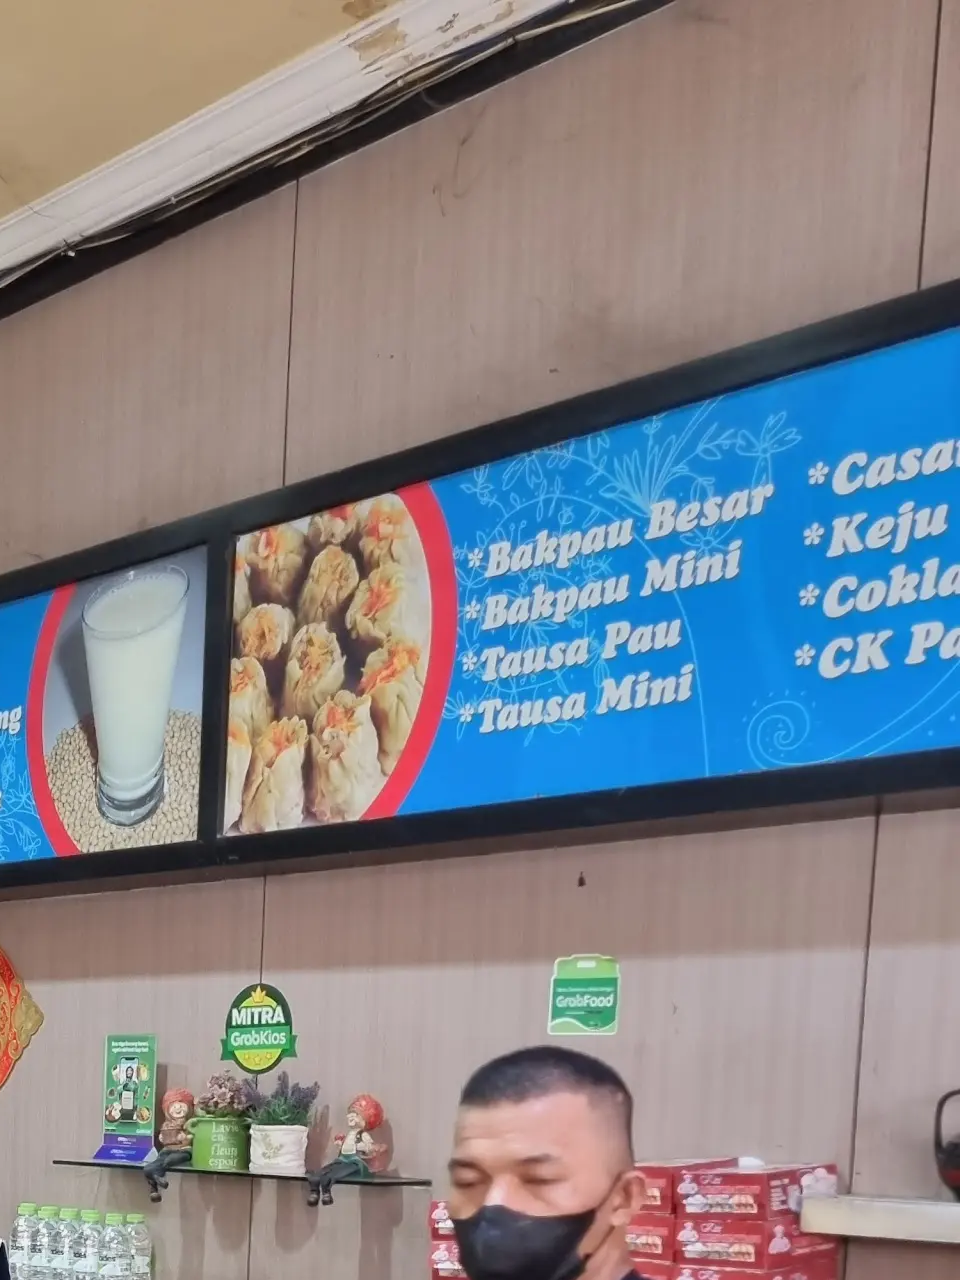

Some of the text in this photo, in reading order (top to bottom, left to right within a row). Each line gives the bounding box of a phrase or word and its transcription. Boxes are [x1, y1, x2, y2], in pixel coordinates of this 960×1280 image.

[831, 437, 960, 496] Casa
[485, 484, 774, 578] Bakpau Besar
[826, 501, 948, 558] Keju
[482, 539, 743, 630] Bakpau Mini
[480, 619, 682, 682] Tausa Pau
[819, 630, 893, 679] CK
[478, 663, 695, 734] Tausa Mini
[231, 1005, 285, 1027] MITRA
[555, 994, 615, 1008] GrabFood
[230, 1031, 287, 1047] GrabKios
